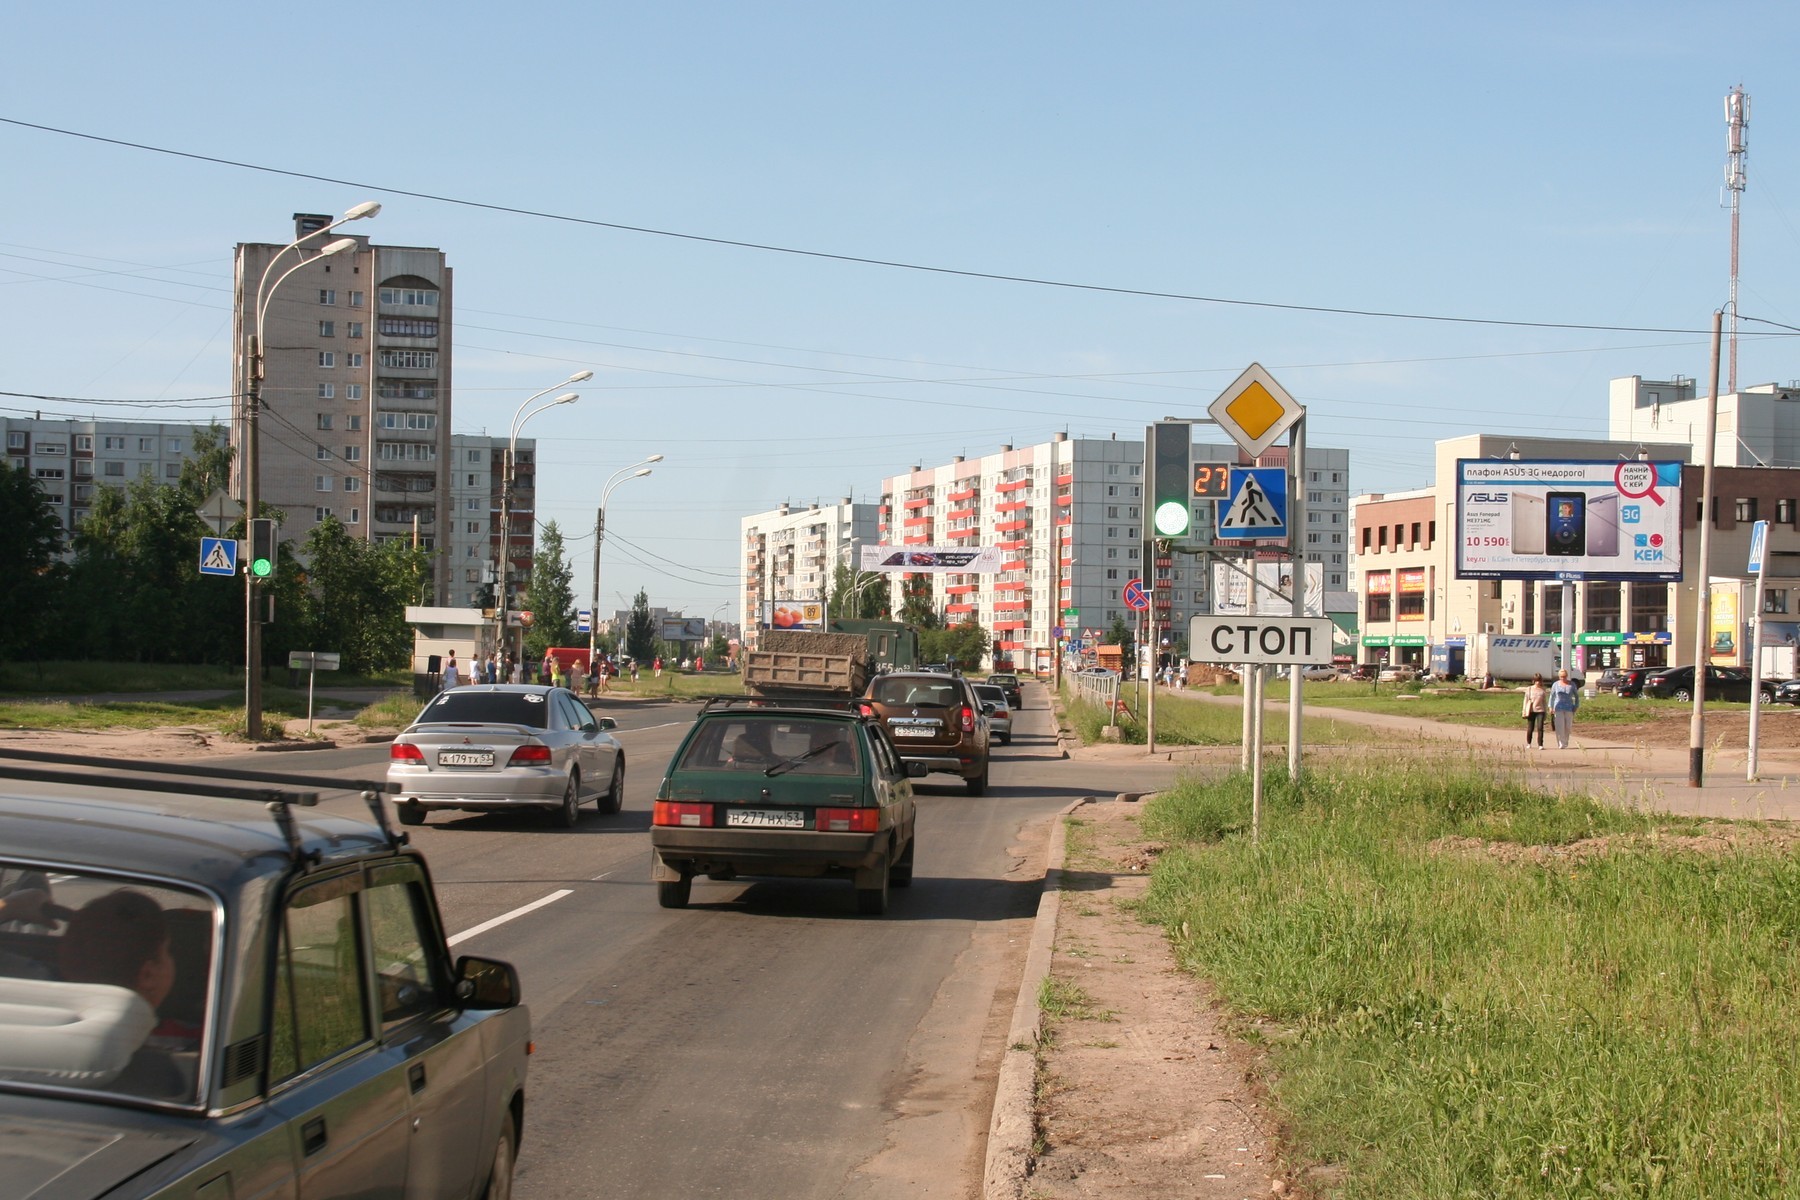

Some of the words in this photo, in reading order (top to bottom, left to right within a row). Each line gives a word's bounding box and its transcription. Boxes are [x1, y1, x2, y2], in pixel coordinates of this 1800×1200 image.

[1466, 468, 1501, 478] плафон
[1503, 468, 1526, 476] ASUS
[1527, 468, 1540, 477] 3G
[1194, 467, 1228, 493] 27
[1466, 493, 1508, 503] ASUS
[1623, 509, 1639, 520] 3G
[1466, 536, 1480, 546] 10
[1483, 537, 1505, 546] 590
[807, 607, 816, 617] 89
[1211, 625, 1311, 655] СТОП
[481, 754, 490, 762] 53
[786, 812, 800, 822] 53
